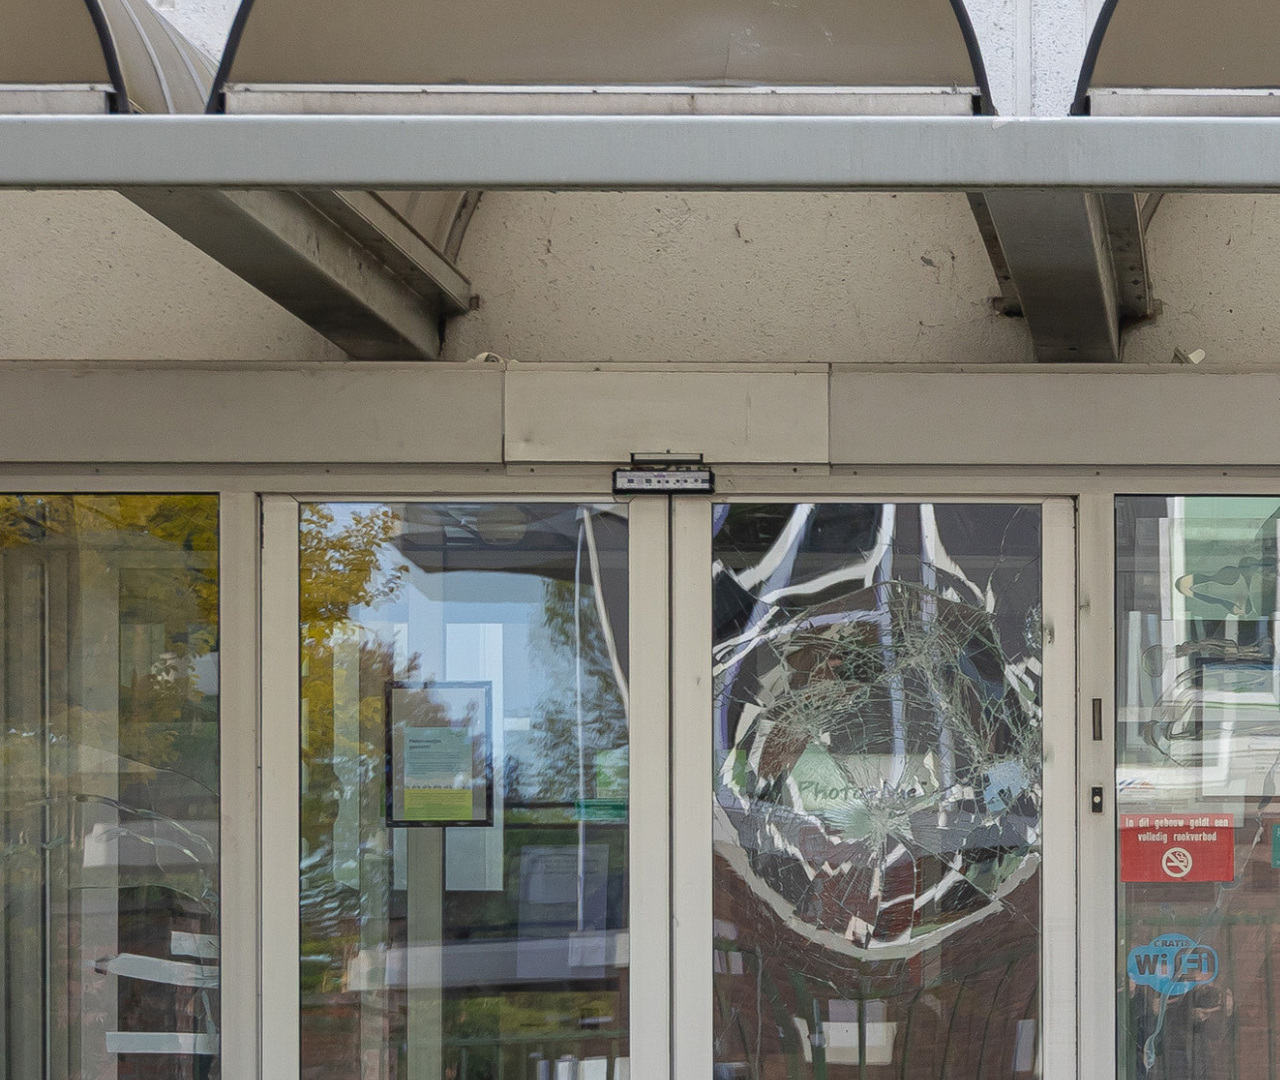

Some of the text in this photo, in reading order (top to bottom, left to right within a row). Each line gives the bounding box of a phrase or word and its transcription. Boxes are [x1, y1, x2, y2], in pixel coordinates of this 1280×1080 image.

[1125, 817, 1229, 830] In dit gebouw geldt een
[1137, 832, 1217, 844] volledig rookverbod
[1153, 939, 1191, 948] GRATIS
